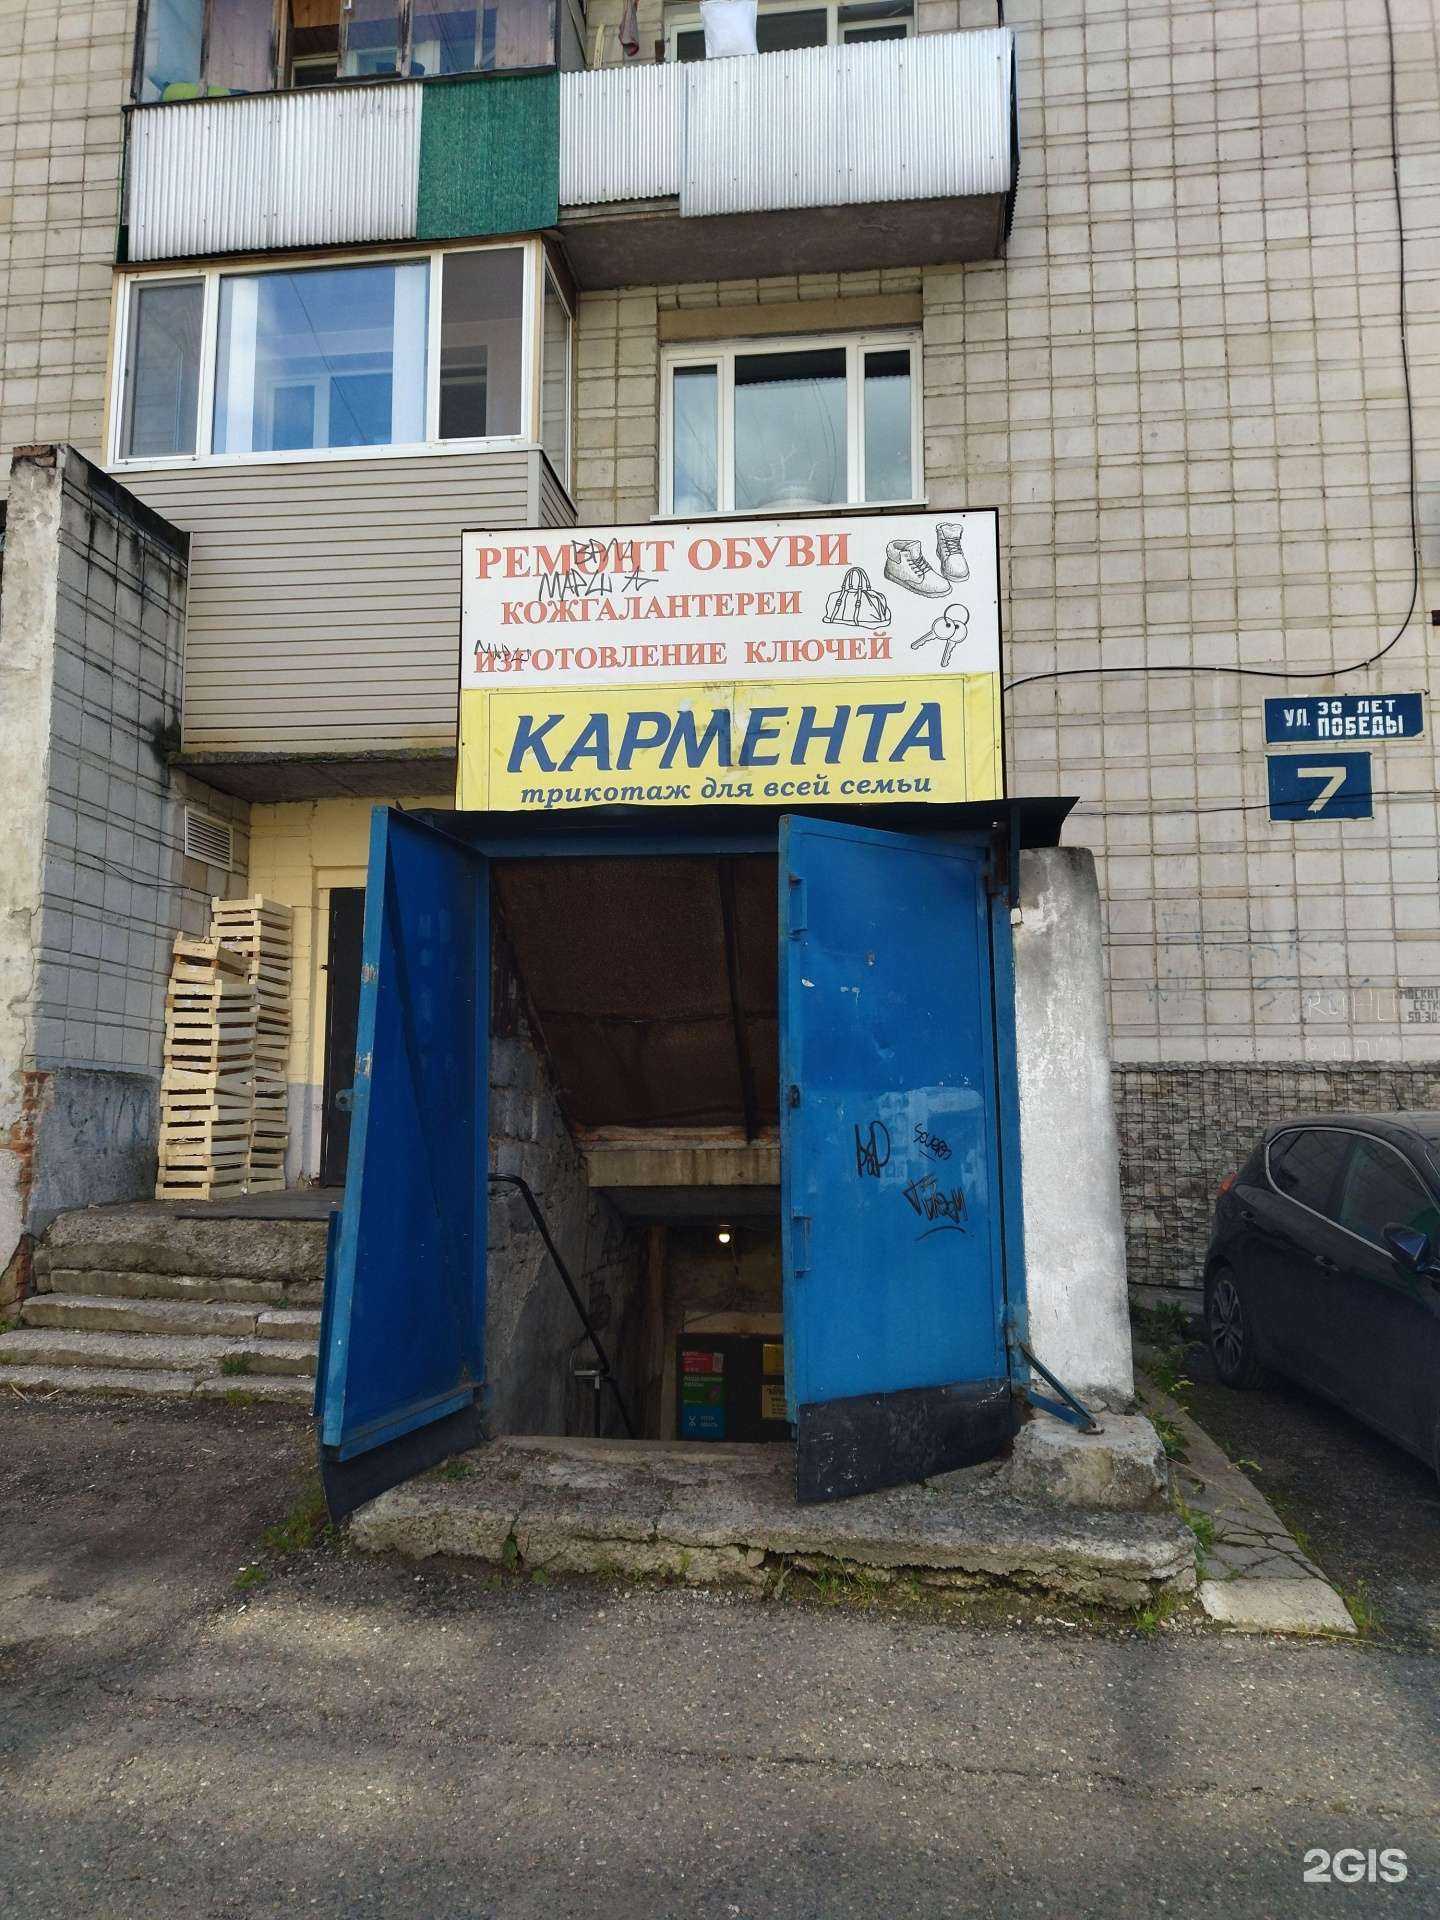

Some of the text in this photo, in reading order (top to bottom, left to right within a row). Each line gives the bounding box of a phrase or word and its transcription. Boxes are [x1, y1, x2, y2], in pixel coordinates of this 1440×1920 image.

[475, 533, 852, 579] РЕМОНТ ОБУВИ
[501, 591, 803, 625] КОЖГАЛАНТЕРЕИ
[474, 632, 893, 673] ИЗГОТОВЛЕНИЕ КЛЮЧЕЙ
[1317, 701, 1343, 715] 30
[1357, 700, 1396, 714] ЛЕТ
[1317, 715, 1404, 737] ПОБЕДЫ
[507, 700, 946, 773] КАРМЕНТА
[521, 774, 932, 808] трикотаж для всей семьи
[1298, 767, 1346, 812] 7
